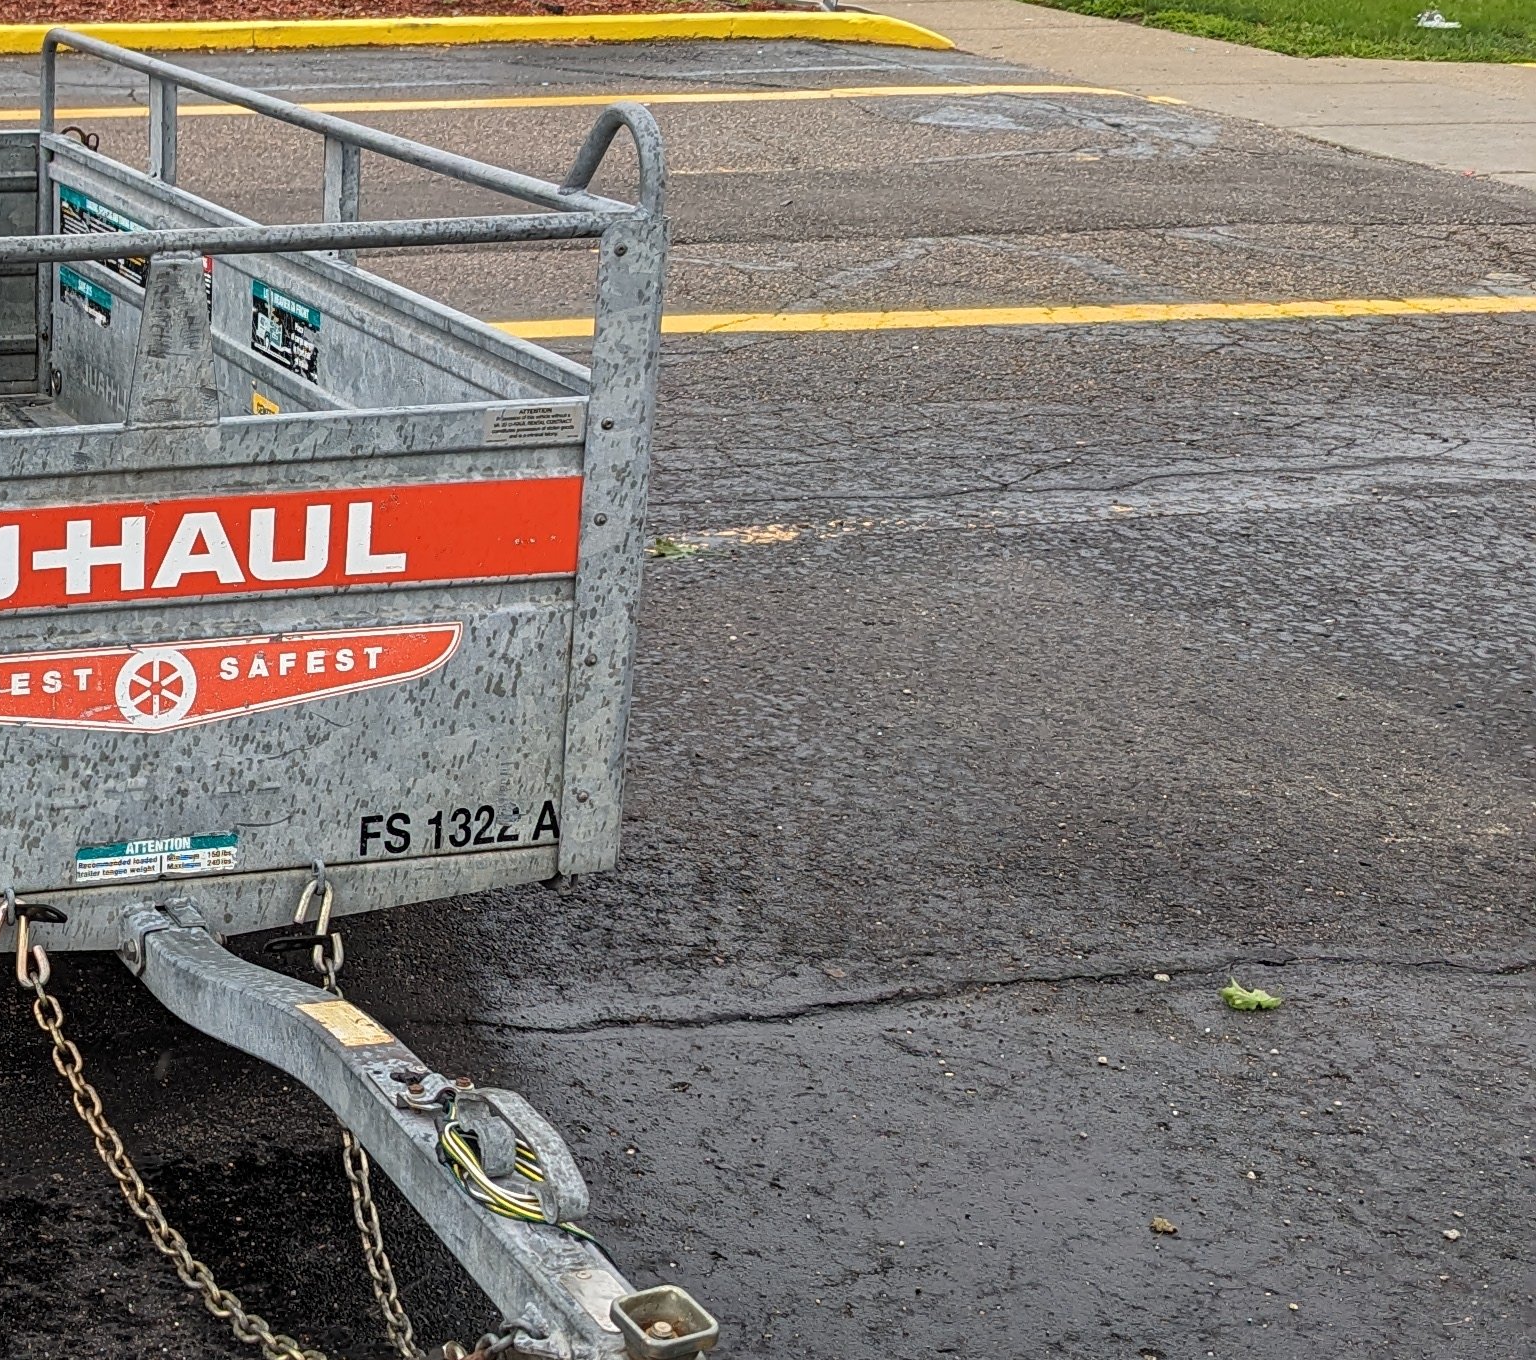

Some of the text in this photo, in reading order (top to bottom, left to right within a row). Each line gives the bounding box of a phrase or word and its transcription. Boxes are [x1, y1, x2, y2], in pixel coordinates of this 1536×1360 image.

[219, 646, 383, 681] SAFEST
[360, 813, 411, 856] FS
[532, 800, 560, 841] A
[125, 837, 191, 855] ATTENTION
[130, 865, 155, 873] weight
[133, 856, 157, 864] loaded
